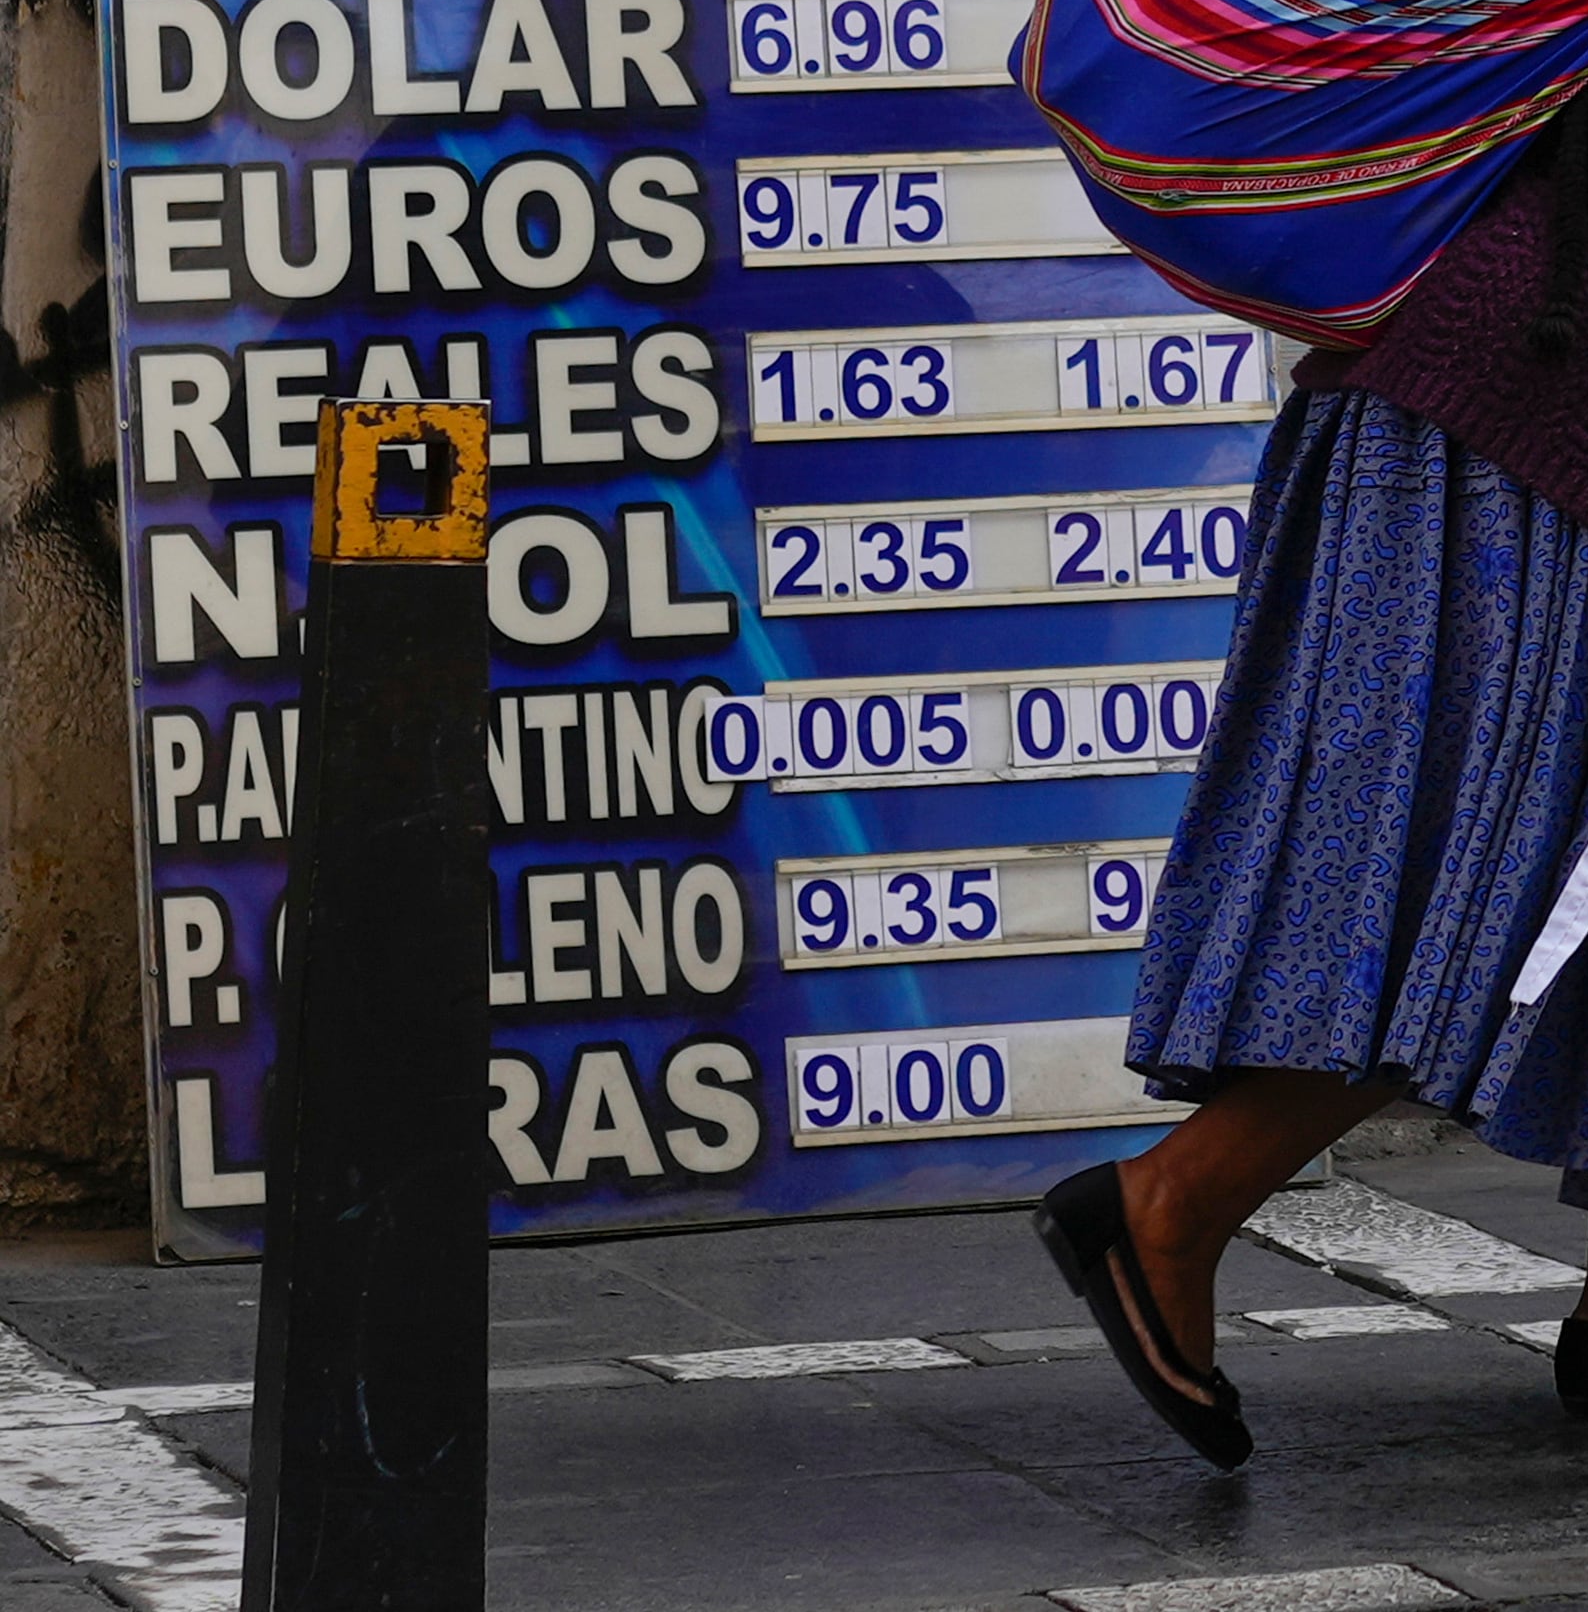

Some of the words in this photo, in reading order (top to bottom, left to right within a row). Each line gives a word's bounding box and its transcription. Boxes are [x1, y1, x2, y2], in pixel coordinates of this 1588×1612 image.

[130, 155, 707, 304] EUROS
[742, 172, 945, 249] 9.75
[760, 344, 951, 423] 1.63
[1065, 332, 1255, 410] 1.67
[488, 511, 732, 646] OL
[770, 518, 970, 598] 2.35
[1054, 505, 1245, 586] 2.40
[709, 691, 968, 777] 0.005
[162, 895, 241, 1028] P.
[797, 868, 998, 953] 9.35
[176, 1042, 760, 1209] LRAS
[801, 1043, 1006, 1127] 9.00
